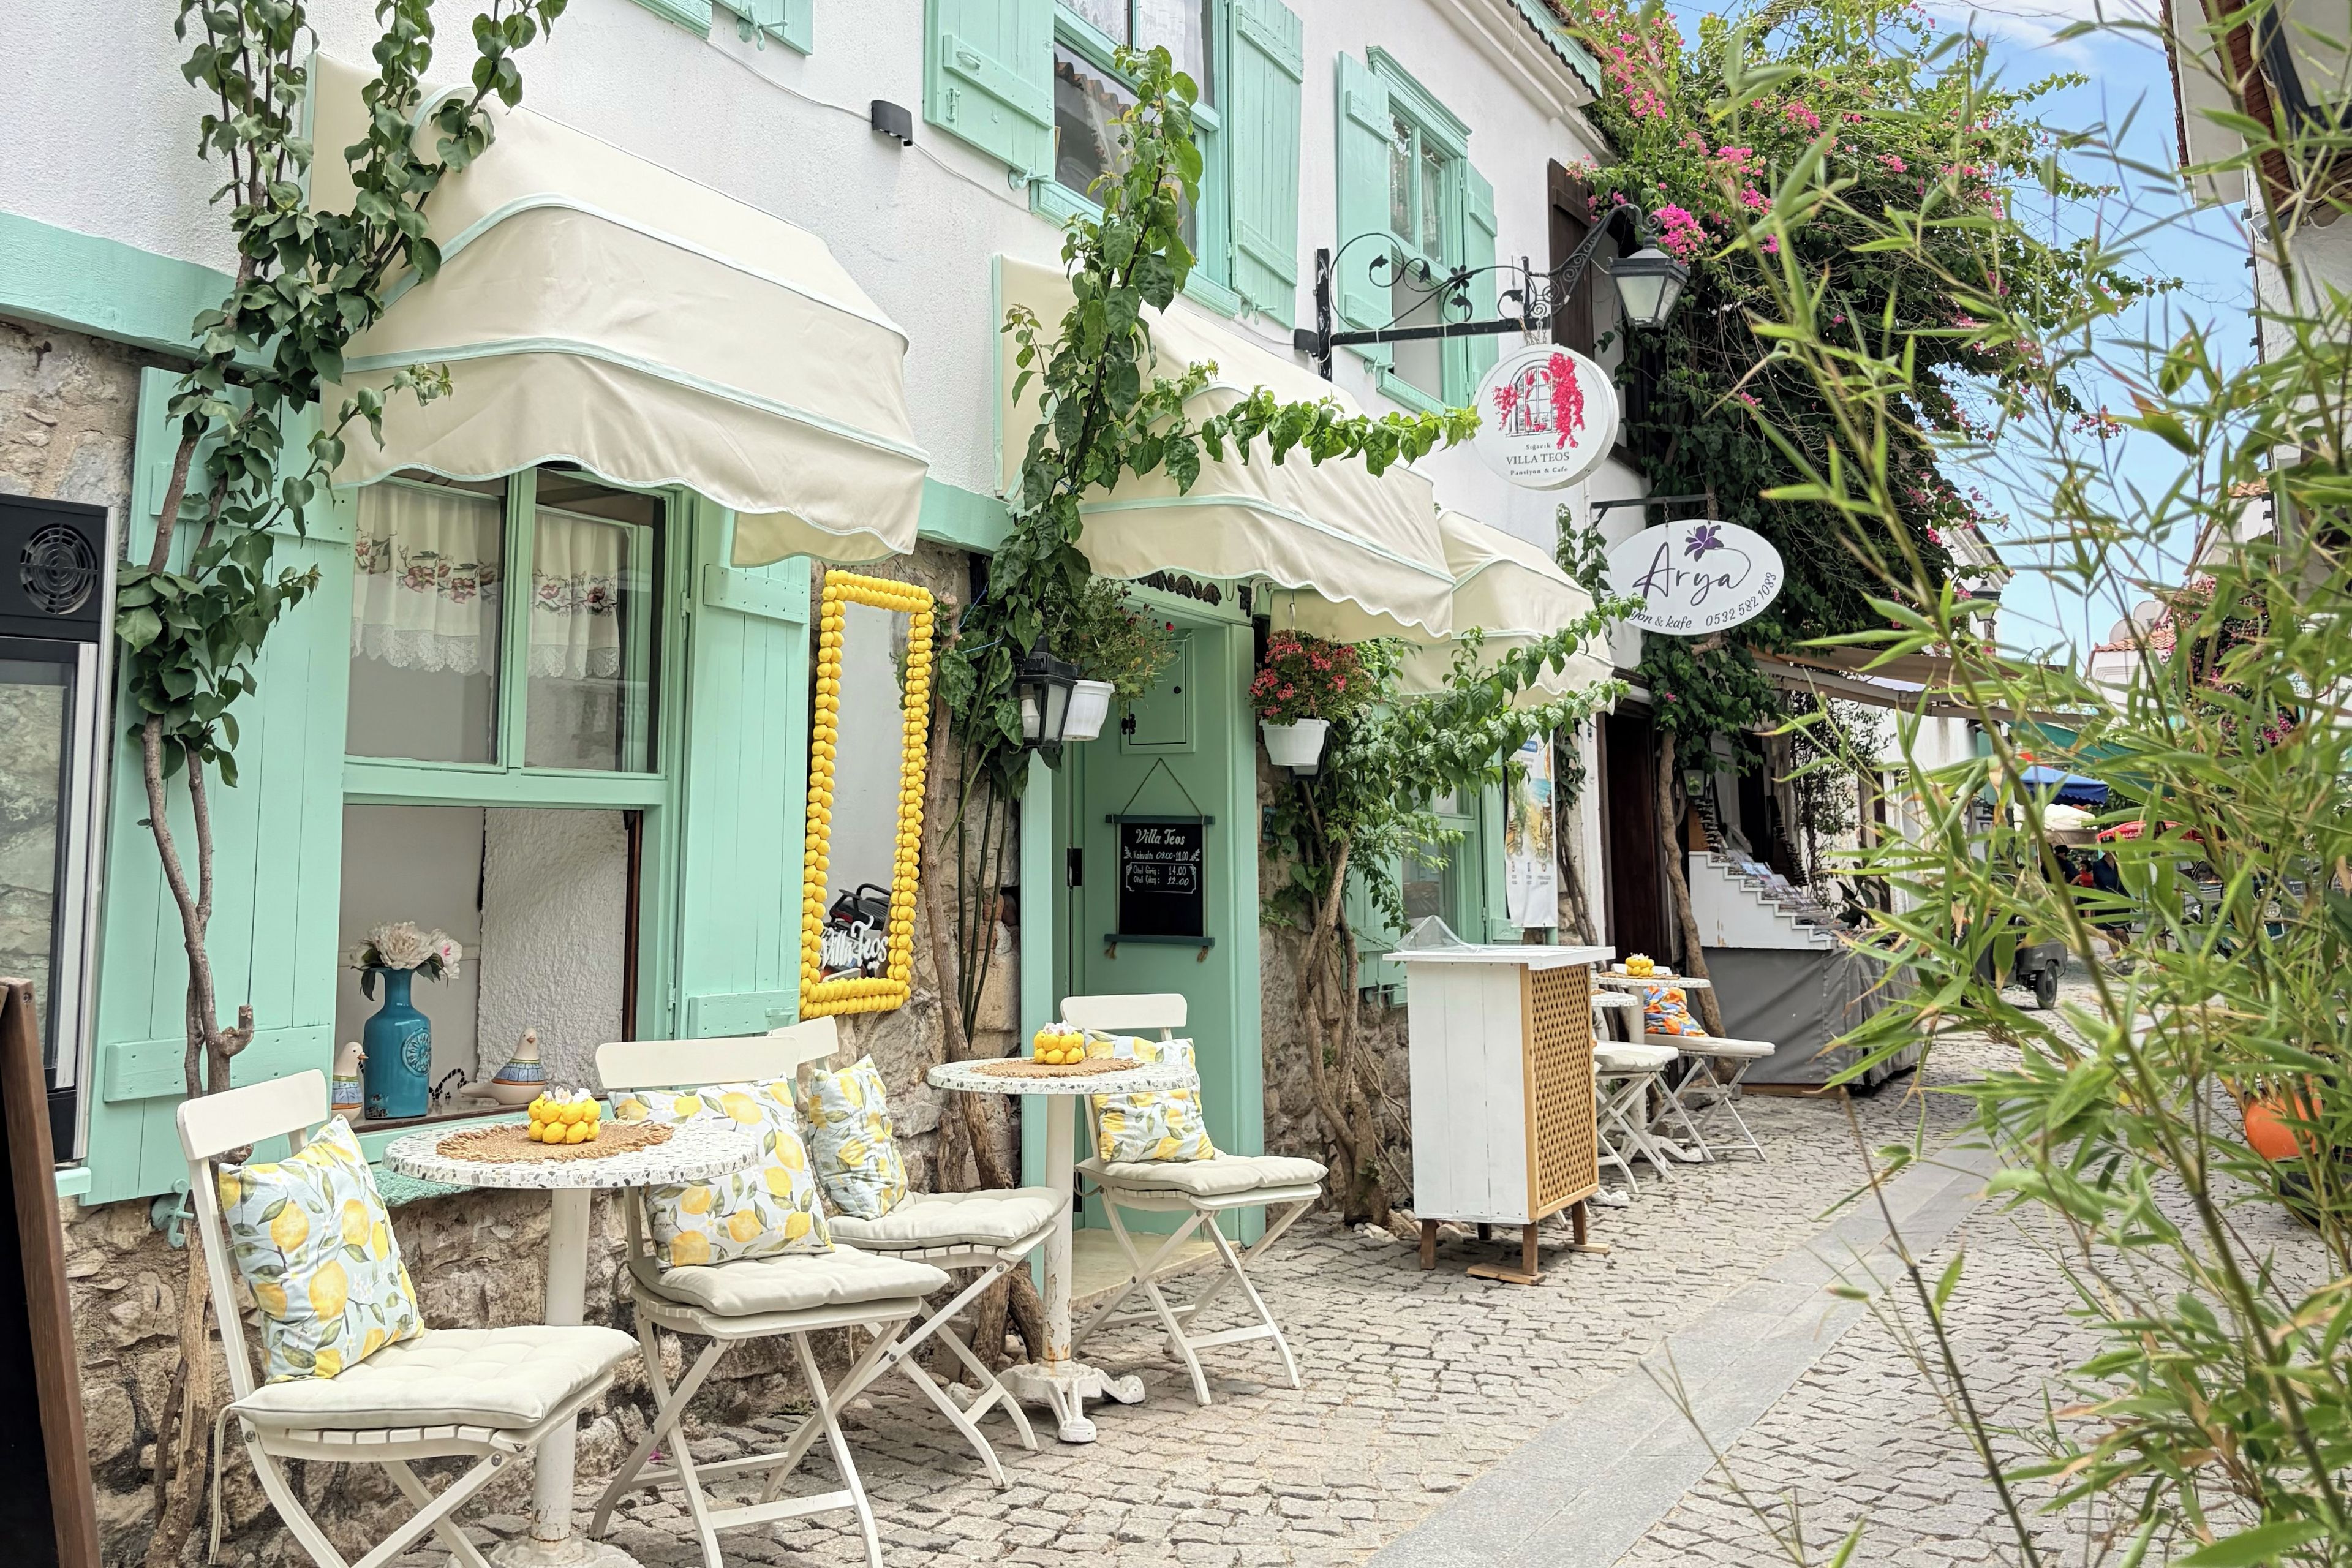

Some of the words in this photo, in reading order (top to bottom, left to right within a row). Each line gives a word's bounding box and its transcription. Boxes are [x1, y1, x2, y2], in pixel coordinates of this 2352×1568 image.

[1506, 455, 1538, 465] VILLA
[1540, 451, 1570, 463] TEOS
[1632, 541, 1746, 606] Arya
[1706, 608, 1736, 627] 0532
[1738, 595, 1759, 616] 582
[1757, 571, 1777, 600] 1083
[1655, 616, 1664, 627] &
[1666, 615, 1692, 630] kafe
[1136, 829, 1162, 845] Villa
[1164, 829, 1185, 845] Teos
[1169, 865, 1186, 876] 14.00
[1167, 876, 1189, 886] 12.00
